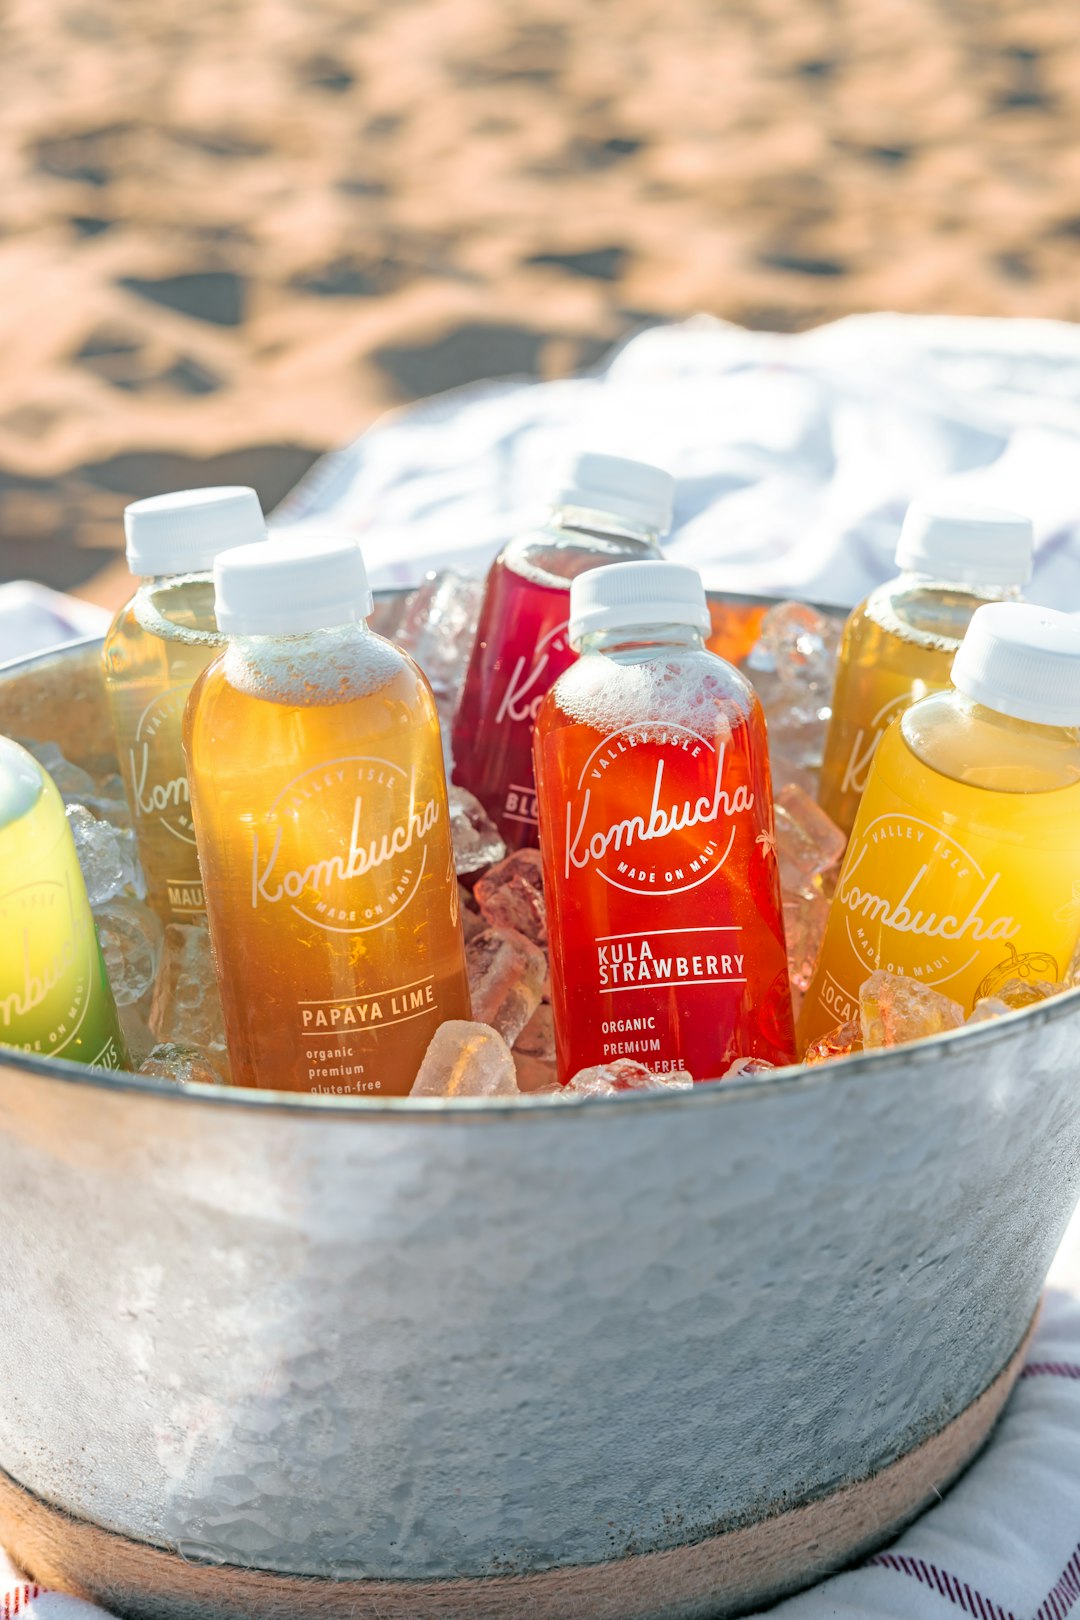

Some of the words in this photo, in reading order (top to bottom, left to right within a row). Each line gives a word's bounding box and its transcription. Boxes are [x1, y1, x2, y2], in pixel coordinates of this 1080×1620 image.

[591, 732, 648, 779] VALLEY
[662, 732, 702, 758] ISLE
[284, 769, 344, 815] VALLEY
[358, 768, 395, 789] ISLE
[565, 741, 754, 879] Kombucha
[252, 763, 440, 908] Kombucha
[872, 824, 924, 845] VALLEY
[933, 842, 969, 879] ISLE
[617, 862, 656, 883] MADE
[665, 869, 684, 882] ON
[689, 840, 717, 872] MAUI
[316, 901, 356, 921] MADE
[365, 905, 383, 919] ON
[389, 868, 413, 905] MAUI
[836, 838, 1021, 941] Kombucha
[598, 941, 653, 966] KULA
[599, 954, 745, 985] STRAWBERRY
[857, 928, 880, 965] MADE
[887, 963, 904, 976] ON
[913, 956, 949, 976] MAUI
[49, 1023, 66, 1043] ON
[69, 976, 84, 1019] MAUI
[302, 1002, 383, 1027] PAPAYA
[392, 984, 435, 1015] LIME
[602, 1017, 656, 1034] ORGANIC
[306, 1046, 354, 1061] organic
[603, 1038, 661, 1055] PREMIUM
[308, 1065, 364, 1079] premium
